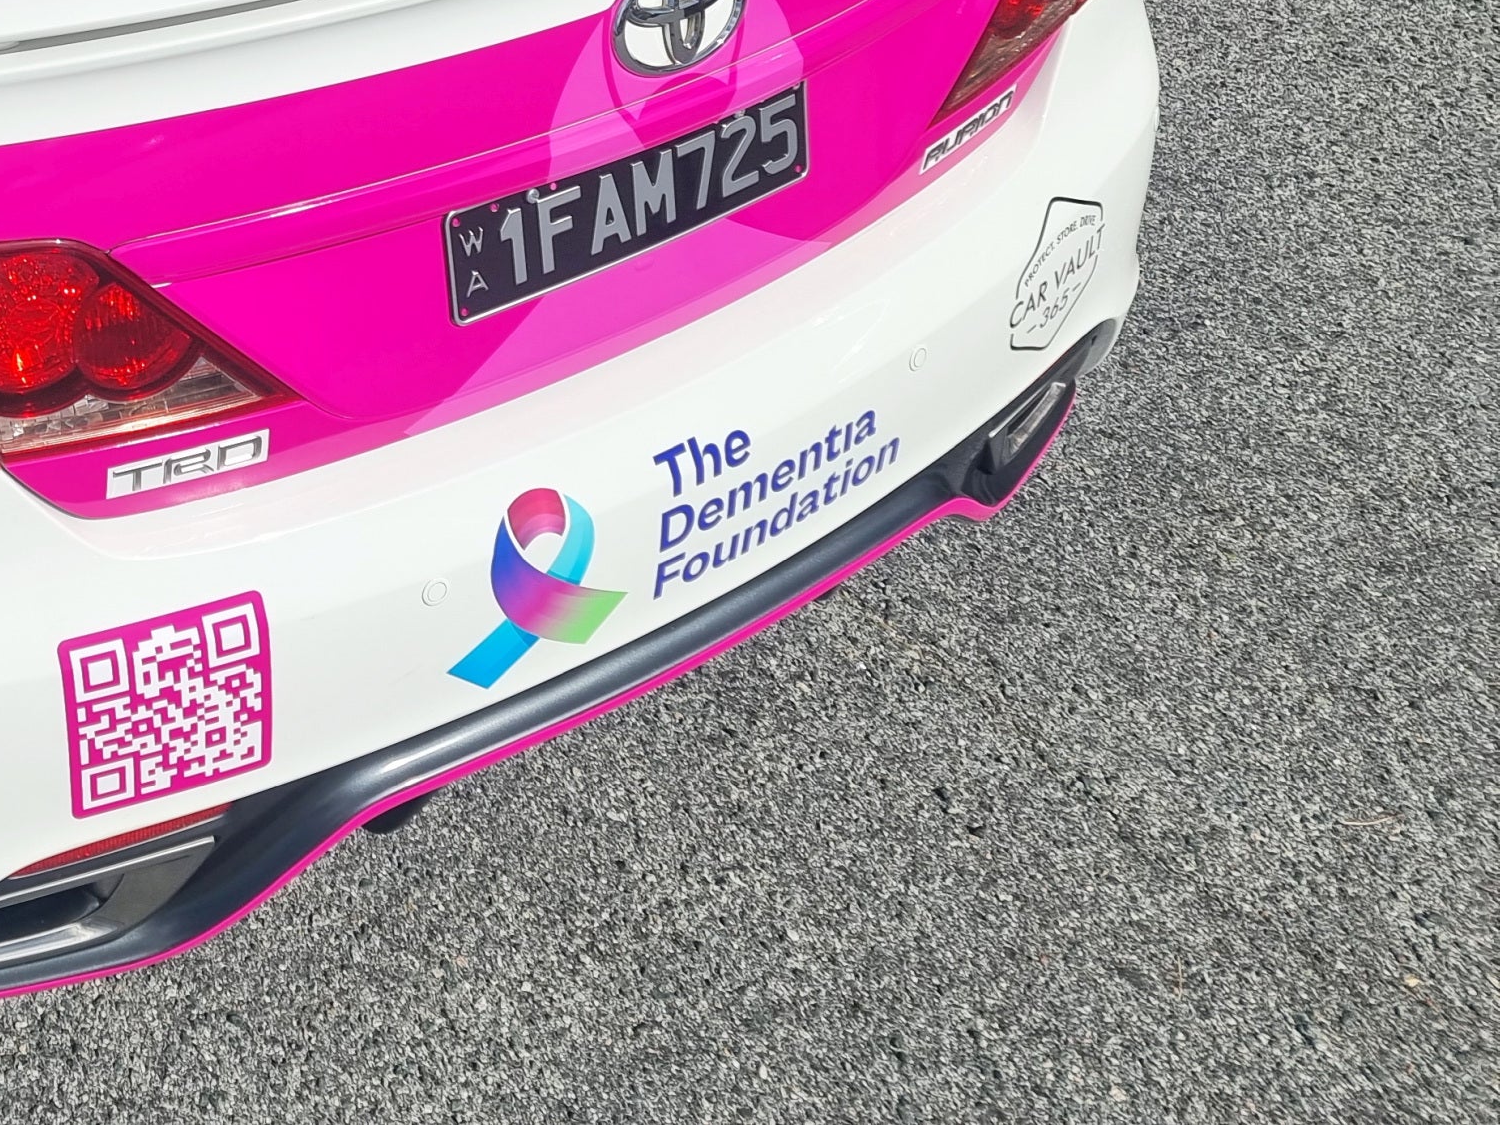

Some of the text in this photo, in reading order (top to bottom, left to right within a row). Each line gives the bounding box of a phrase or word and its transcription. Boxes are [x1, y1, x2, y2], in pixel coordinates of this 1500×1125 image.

[923, 90, 1014, 171] AURION
[500, 93, 800, 285] 1FAM725
[1009, 223, 1106, 329] CAR VAULT
[112, 435, 263, 492] TRD
[652, 429, 751, 498] The
[658, 409, 877, 553] Dementia
[652, 436, 901, 601] Foundation
